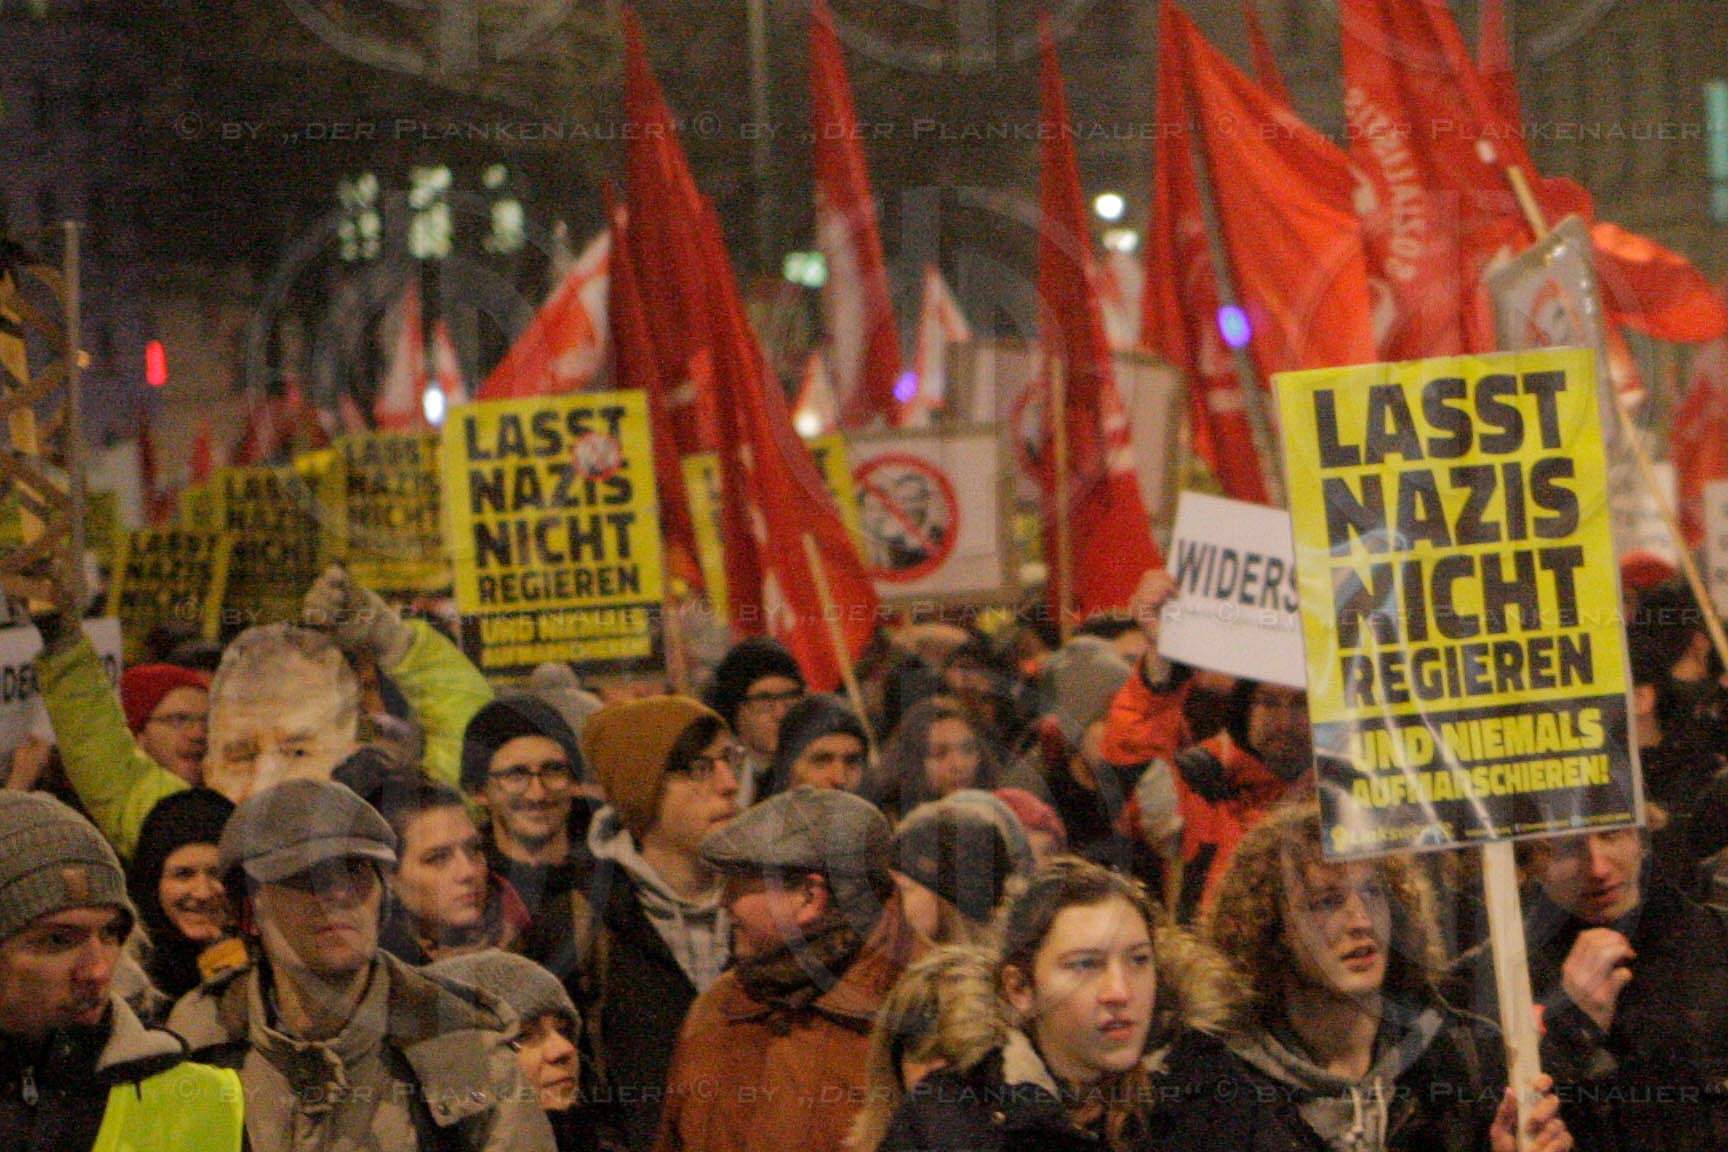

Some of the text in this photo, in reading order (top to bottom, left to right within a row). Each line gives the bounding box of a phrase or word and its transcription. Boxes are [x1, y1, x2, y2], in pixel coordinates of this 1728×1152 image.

[464, 406, 626, 460] LASST
[1313, 370, 1567, 469] LASST
[473, 512, 636, 568] NICHT
[1321, 456, 1580, 557] NAZIS
[478, 563, 641, 605] REGIEREN
[1330, 545, 1585, 648] NICHT
[1341, 632, 1595, 709] REGIEREN
[1352, 706, 1606, 773] UND NIEMALS
